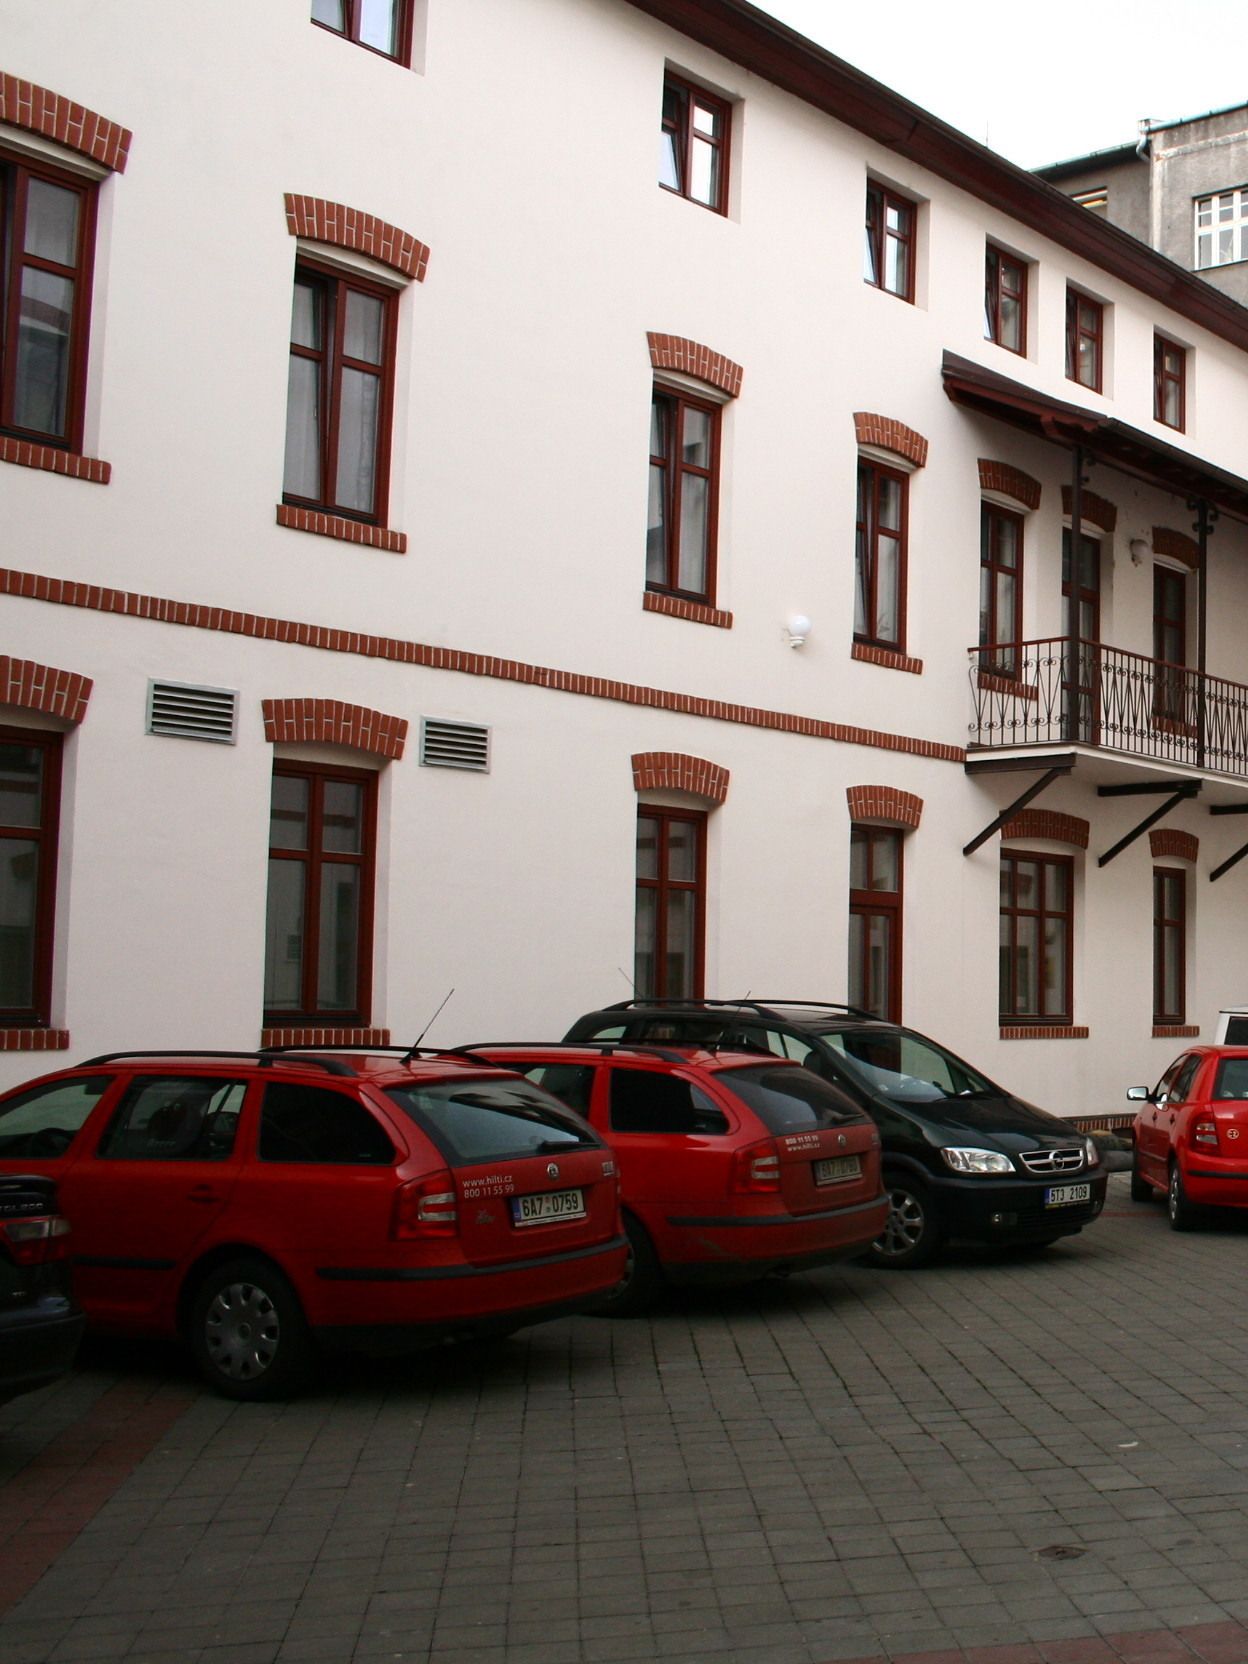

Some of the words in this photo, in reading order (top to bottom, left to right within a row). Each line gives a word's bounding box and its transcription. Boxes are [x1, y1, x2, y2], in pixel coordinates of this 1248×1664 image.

[462, 1175, 512, 1187] www.hilti.cz
[464, 1188, 480, 1199] 800
[482, 1187, 491, 1197] 11
[493, 1185, 503, 1195] 55
[505, 1184, 514, 1193] 99
[1051, 1189, 1065, 1202] 5T3
[1070, 1186, 1087, 1201] 2109
[522, 1196, 543, 1217] 6A7
[552, 1193, 579, 1213] 0759
